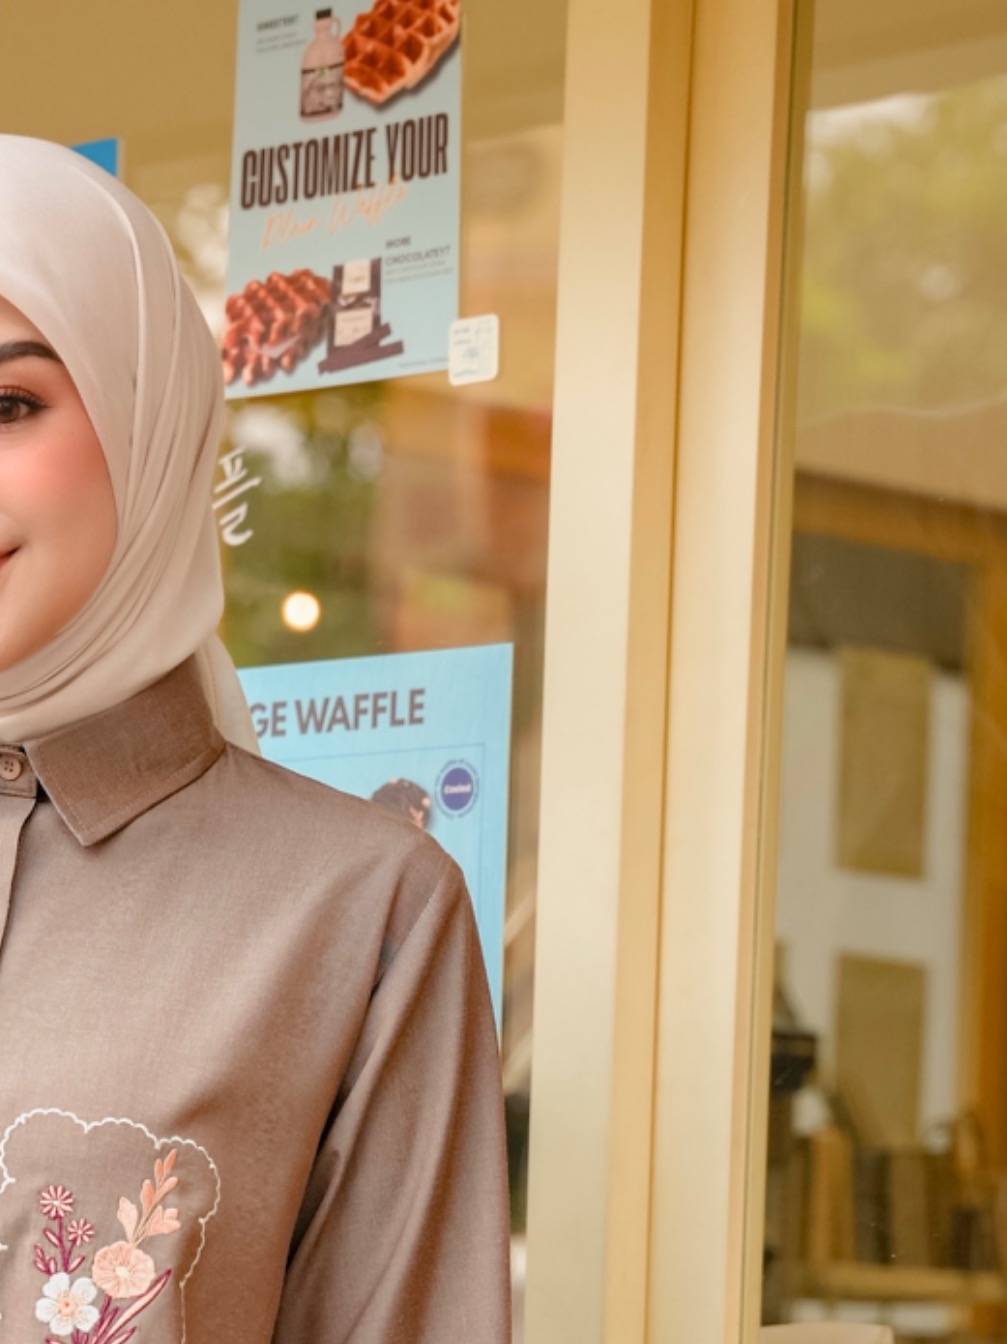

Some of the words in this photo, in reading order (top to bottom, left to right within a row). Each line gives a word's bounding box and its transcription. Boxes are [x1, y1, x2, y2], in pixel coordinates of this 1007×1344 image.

[240, 127, 377, 210] CUSTOMIZE
[385, 112, 449, 184] YOUR
[295, 688, 426, 735] WAFFLE
